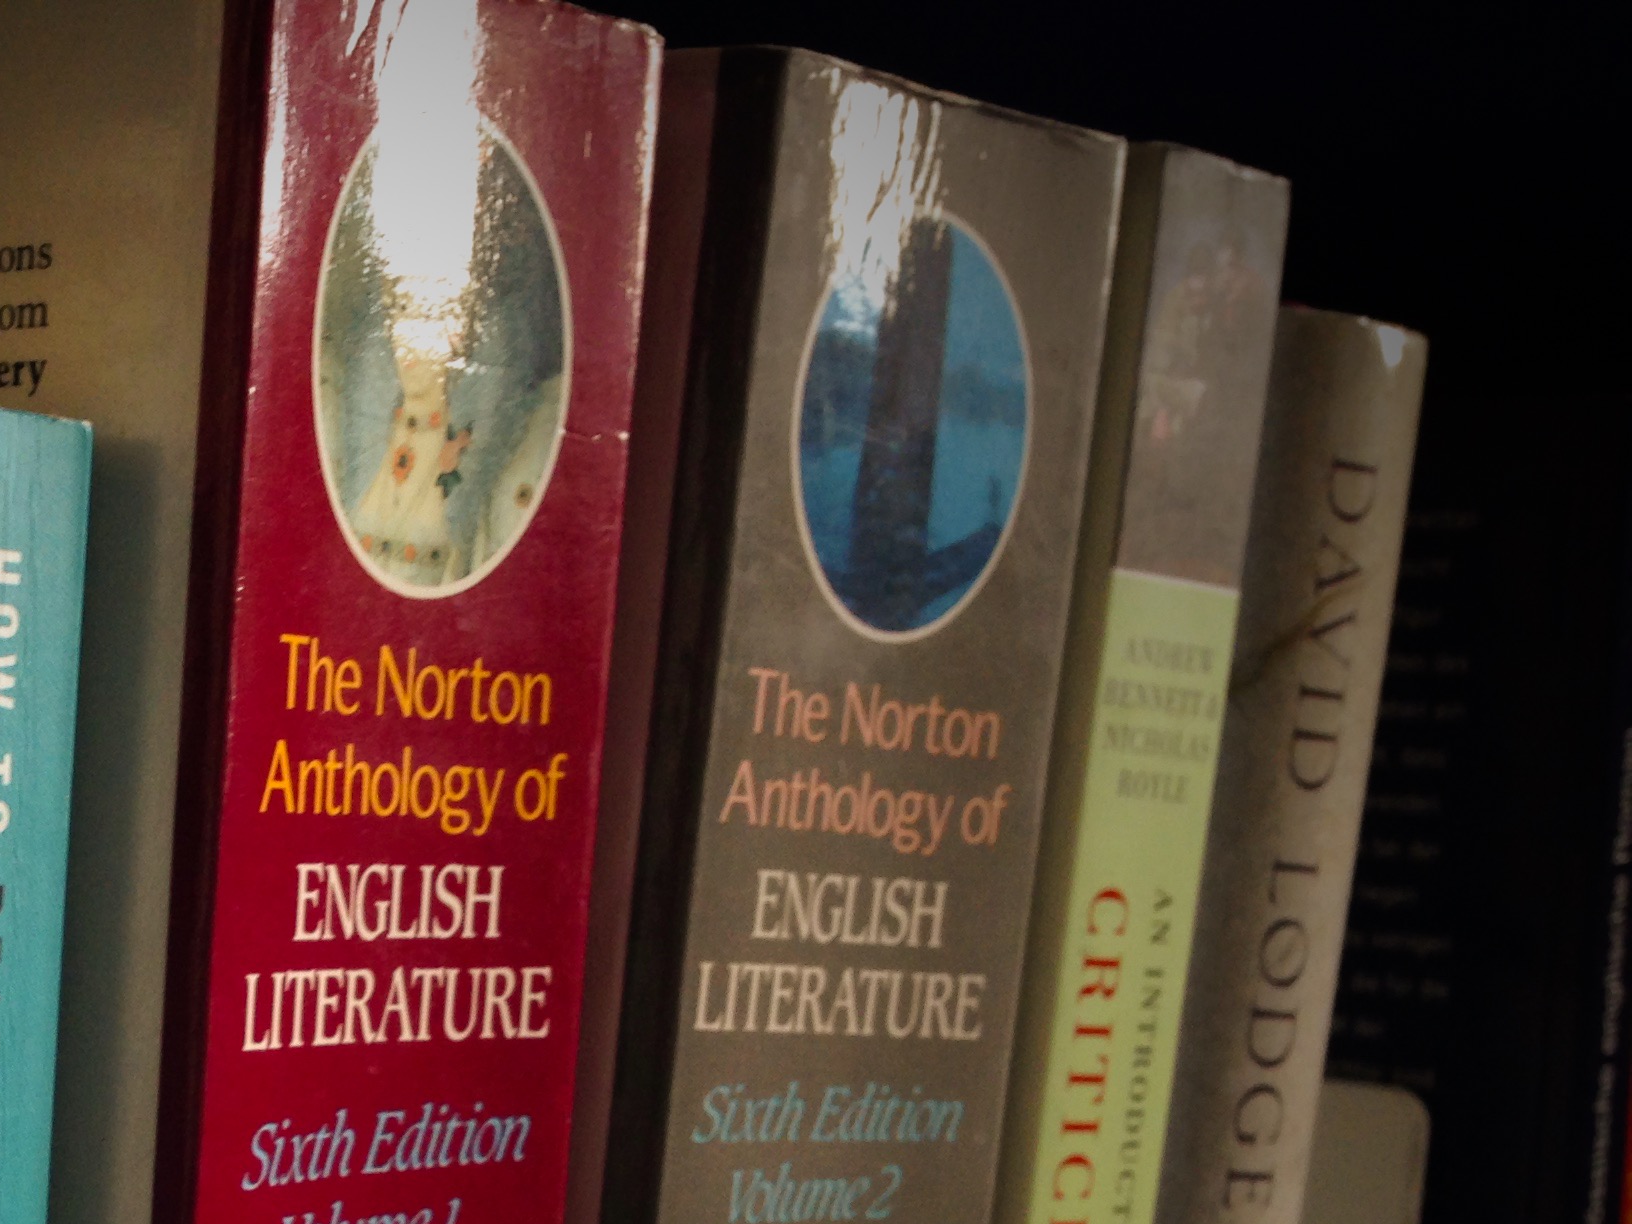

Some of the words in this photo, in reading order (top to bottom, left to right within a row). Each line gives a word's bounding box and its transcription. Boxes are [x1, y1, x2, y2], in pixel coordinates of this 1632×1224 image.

[1288, 459, 1378, 791] DAVID
[280, 633, 362, 716] The
[375, 645, 552, 725] Norton
[748, 667, 829, 743] The
[840, 681, 1002, 760] Norton
[259, 739, 505, 836] Anthology
[514, 753, 568, 821] of
[719, 759, 955, 857] Anthology
[961, 783, 1013, 849] of
[292, 863, 505, 942] ENGLISH
[751, 869, 949, 949] ENGLISH
[242, 966, 553, 1051] LITERATURE
[693, 961, 987, 1041] LITERATURE
[1223, 861, 1320, 1208] LODGE
[241, 1108, 357, 1191] Sixth
[362, 1101, 532, 1176] Edition
[692, 1081, 806, 1145] Sixth
[811, 1081, 965, 1144] Edition
[729, 1162, 871, 1224] Volume
[865, 1164, 903, 1219] 2
